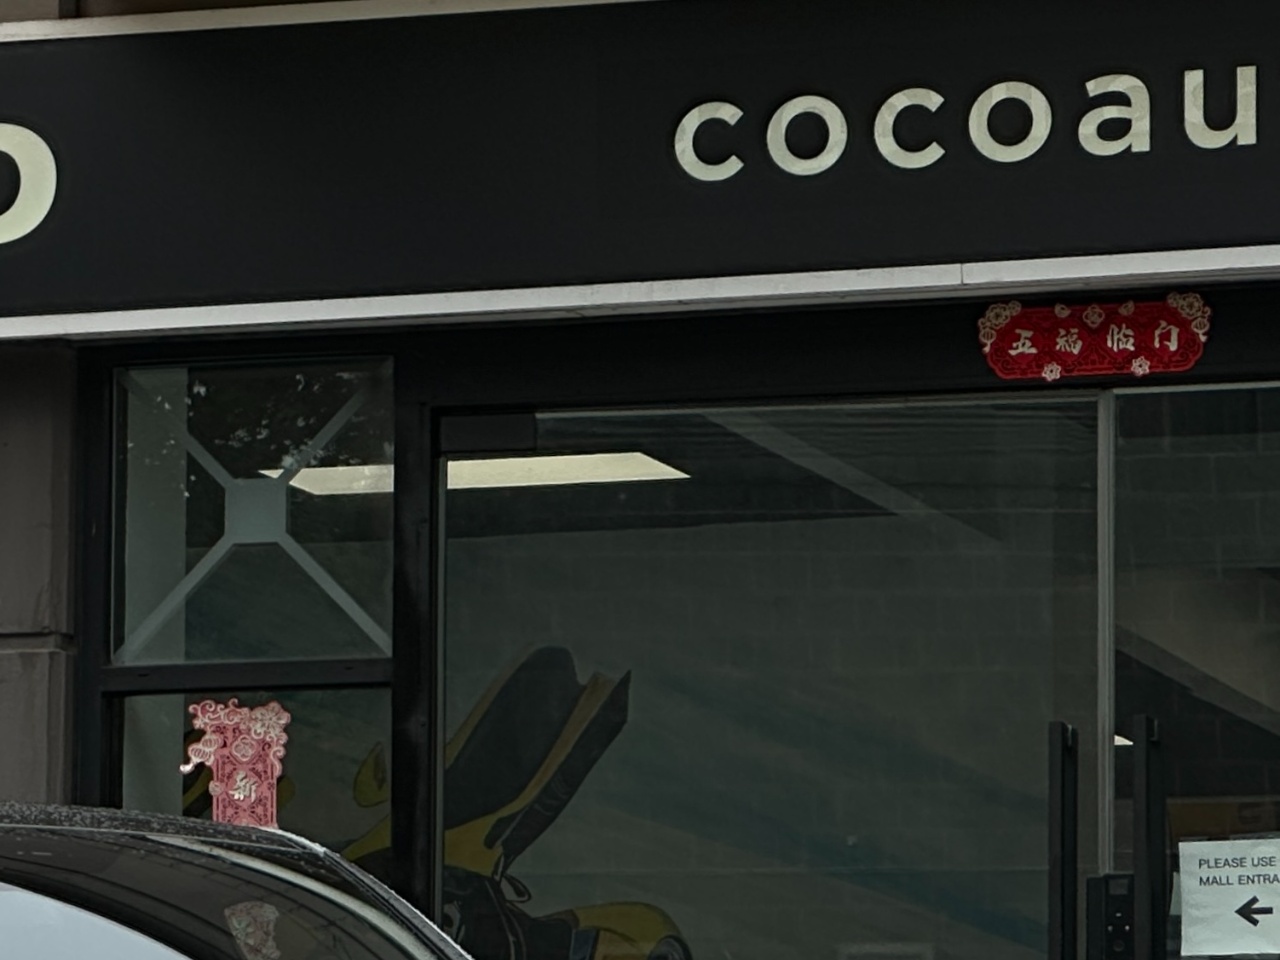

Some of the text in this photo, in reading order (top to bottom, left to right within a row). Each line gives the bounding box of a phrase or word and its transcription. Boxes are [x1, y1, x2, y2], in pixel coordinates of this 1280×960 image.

[674, 65, 1258, 182] cocoau
[1008, 320, 1180, 356] 五福临门
[1198, 856, 1277, 870] PLEASE USE
[1199, 873, 1280, 887] MALL ENTRA
